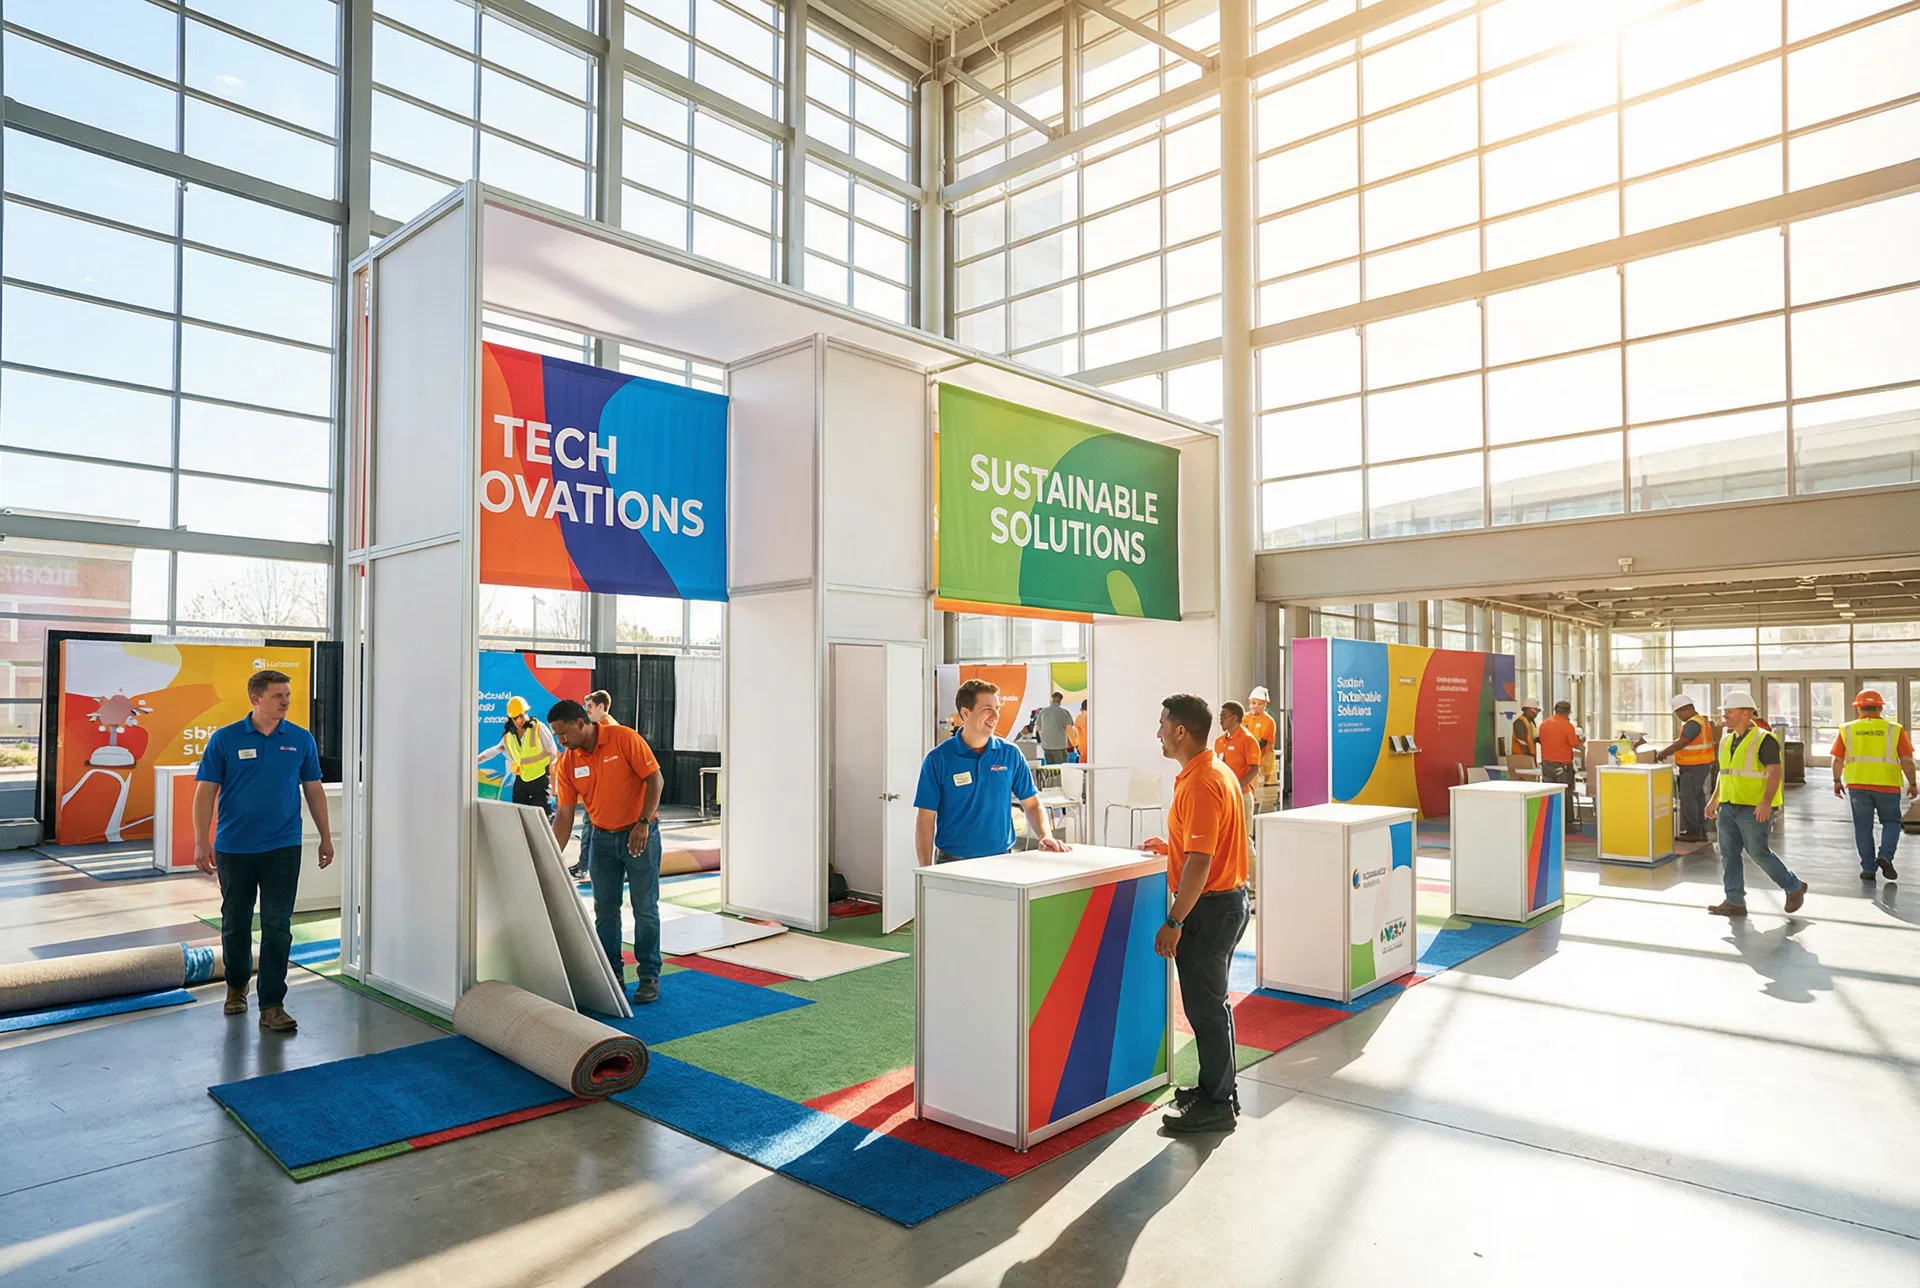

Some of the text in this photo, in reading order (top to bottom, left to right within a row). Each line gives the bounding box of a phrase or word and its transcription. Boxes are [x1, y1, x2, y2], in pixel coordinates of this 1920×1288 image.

[493, 413, 617, 475] TECH
[480, 469, 705, 537] OVATIONS
[970, 453, 1159, 525] SUSTAINABLE
[990, 506, 1146, 565] SOLUTIONS
